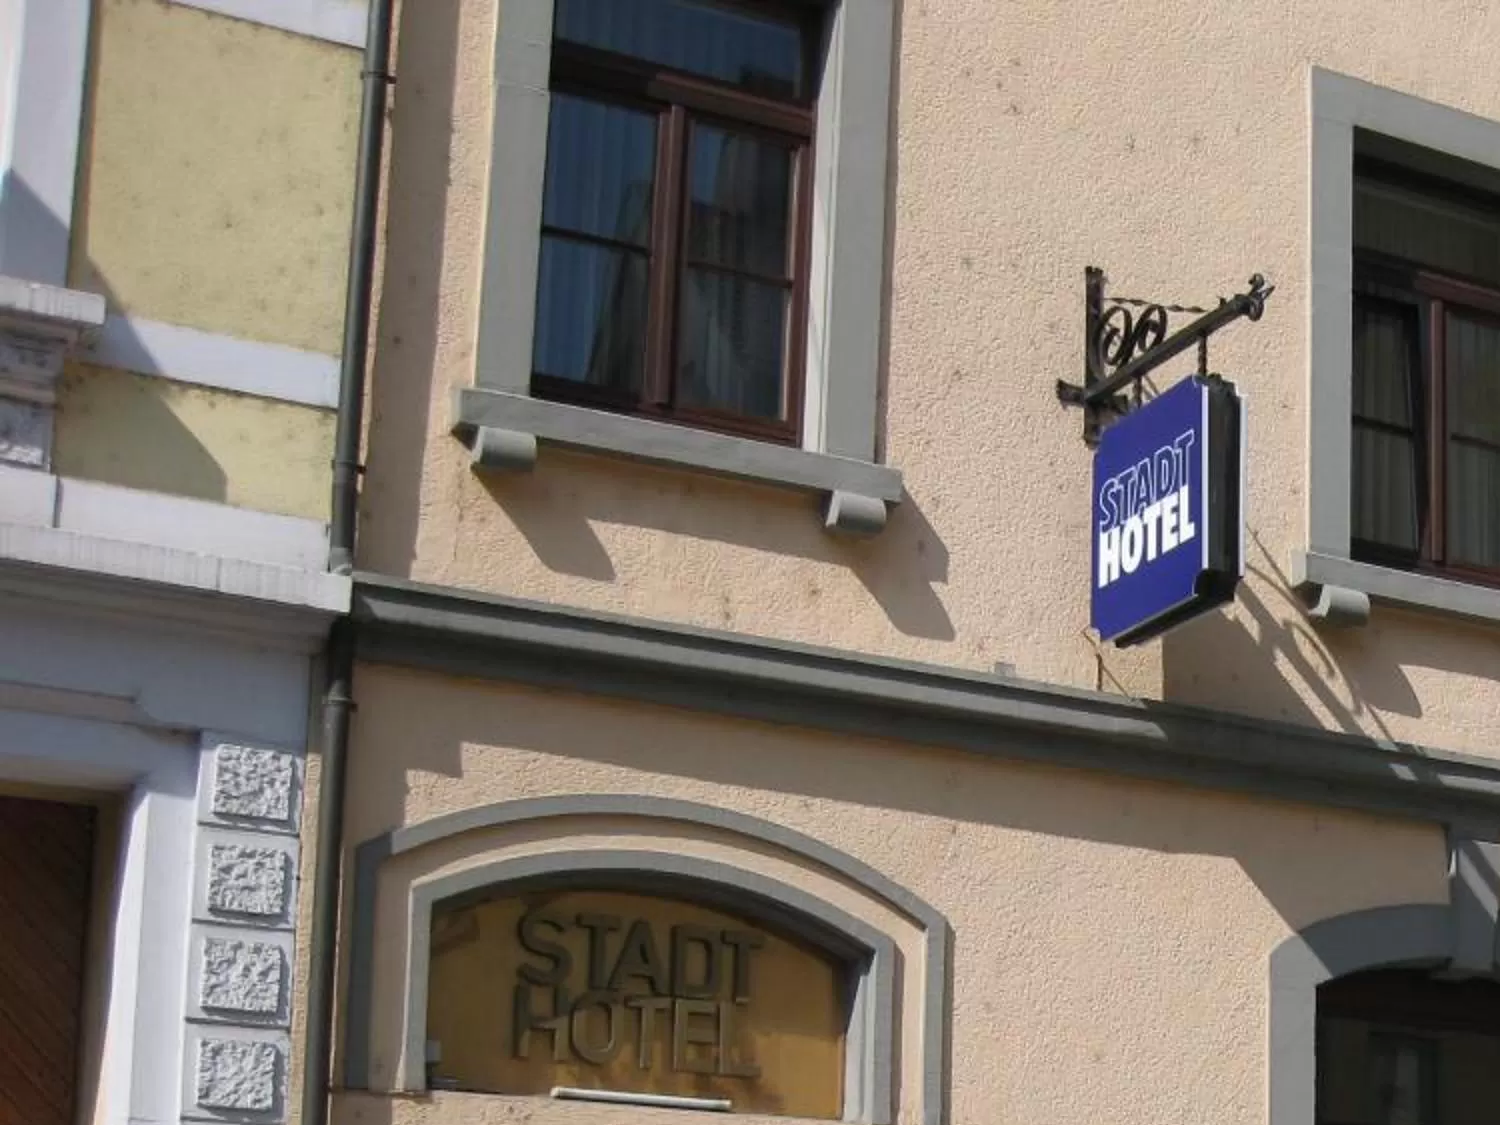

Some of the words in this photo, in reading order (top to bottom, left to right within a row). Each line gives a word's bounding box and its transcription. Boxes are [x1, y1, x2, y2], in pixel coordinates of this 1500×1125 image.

[1100, 428, 1195, 525] STADT
[1099, 487, 1195, 588] HOTEL
[517, 911, 766, 1003] STADT
[512, 985, 761, 1077] HOTEL
